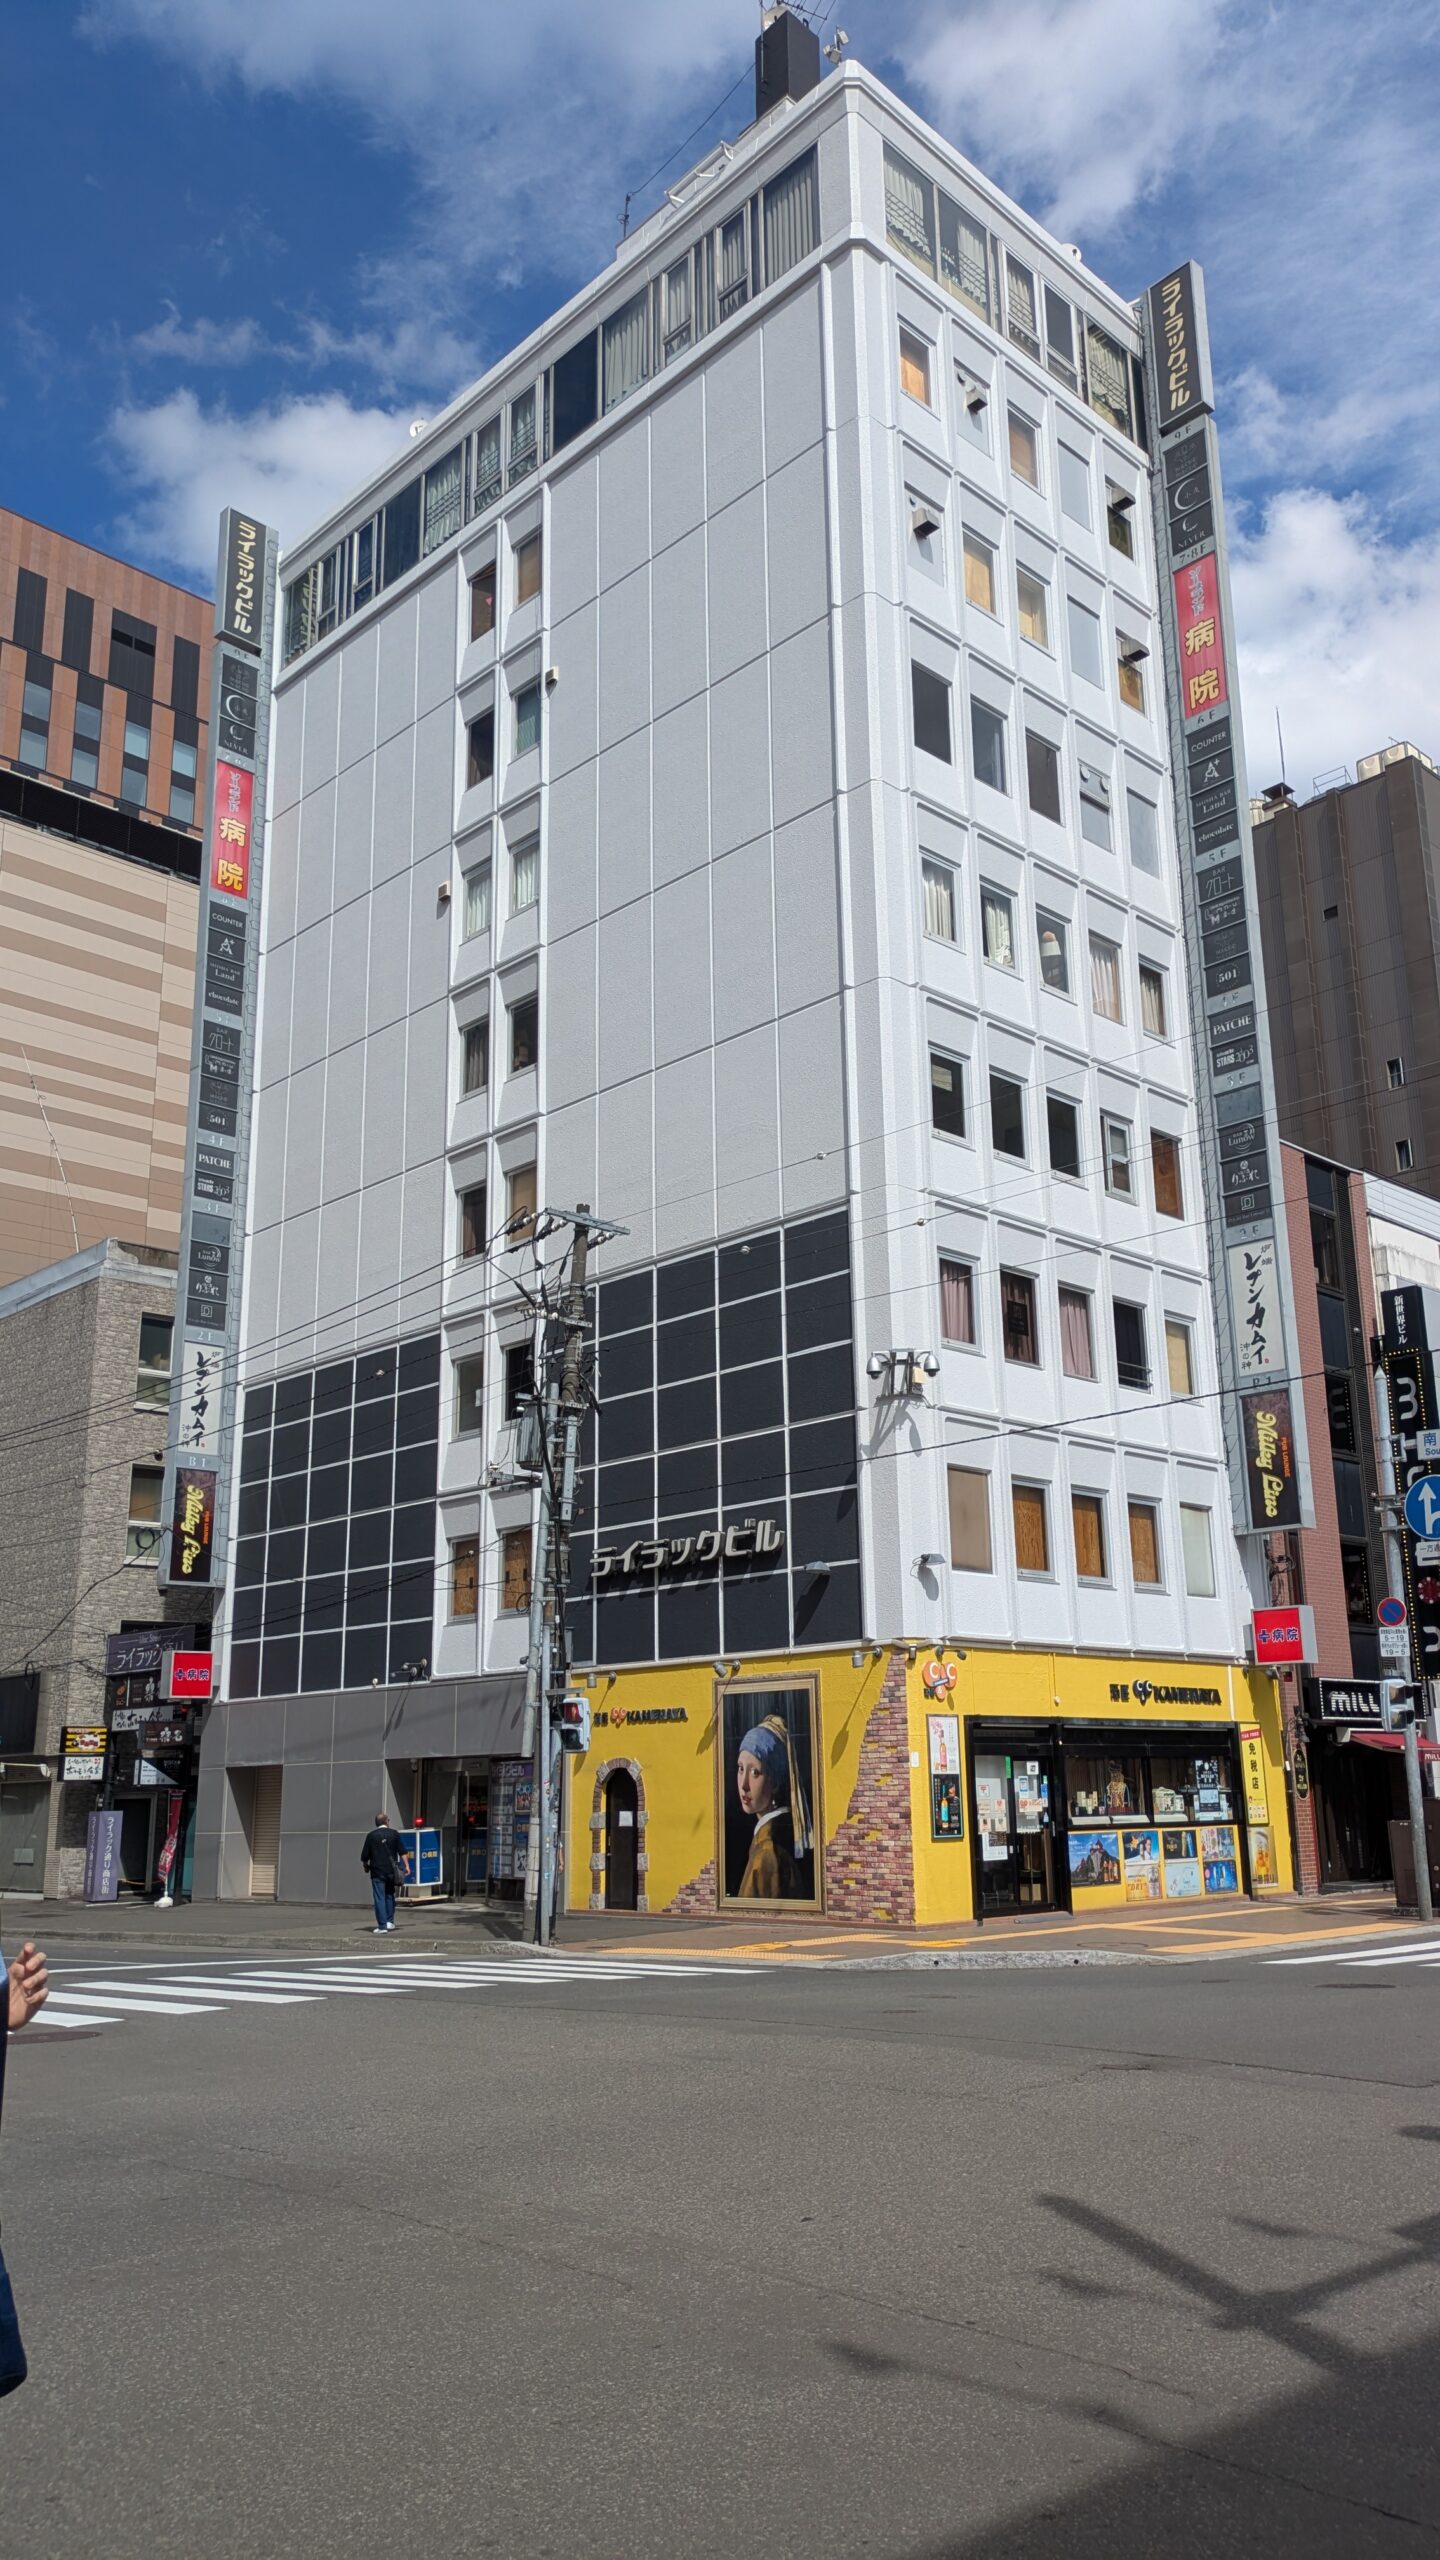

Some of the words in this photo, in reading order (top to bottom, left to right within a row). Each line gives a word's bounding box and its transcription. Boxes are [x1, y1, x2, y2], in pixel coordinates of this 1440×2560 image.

[1162, 277, 1190, 411] ライラックビル
[234, 520, 256, 634] ライラックビル
[1185, 616, 1220, 710] 病院
[1191, 730, 1227, 753] COUNTER
[1203, 797, 1227, 814] Land
[1198, 823, 1234, 843] chocolate
[217, 817, 247, 891] 病院
[211, 912, 244, 929] COUNTER
[215, 968, 235, 982] Land
[1218, 969, 1237, 983] 501
[1213, 1015, 1252, 1036] PATCHE
[209, 1114, 226, 1126] 501
[198, 1153, 232, 1169] PATCHE
[1244, 1252, 1267, 1365] レプンカムイ
[191, 1351, 211, 1448] レプンカムイ
[1255, 1410, 1279, 1470] Milky
[1281, 1437, 1289, 1450] PUB
[1422, 1432, 1437, 1446] 南
[1282, 1450, 1291, 1478] LOUNGE
[181, 1485, 205, 1533] Milky
[590, 1518, 785, 1577] ライラックビル
[1271, 1627, 1300, 1643] 病院
[187, 1668, 210, 1681] 病院
[1248, 1742, 1260, 1790] 免税店
